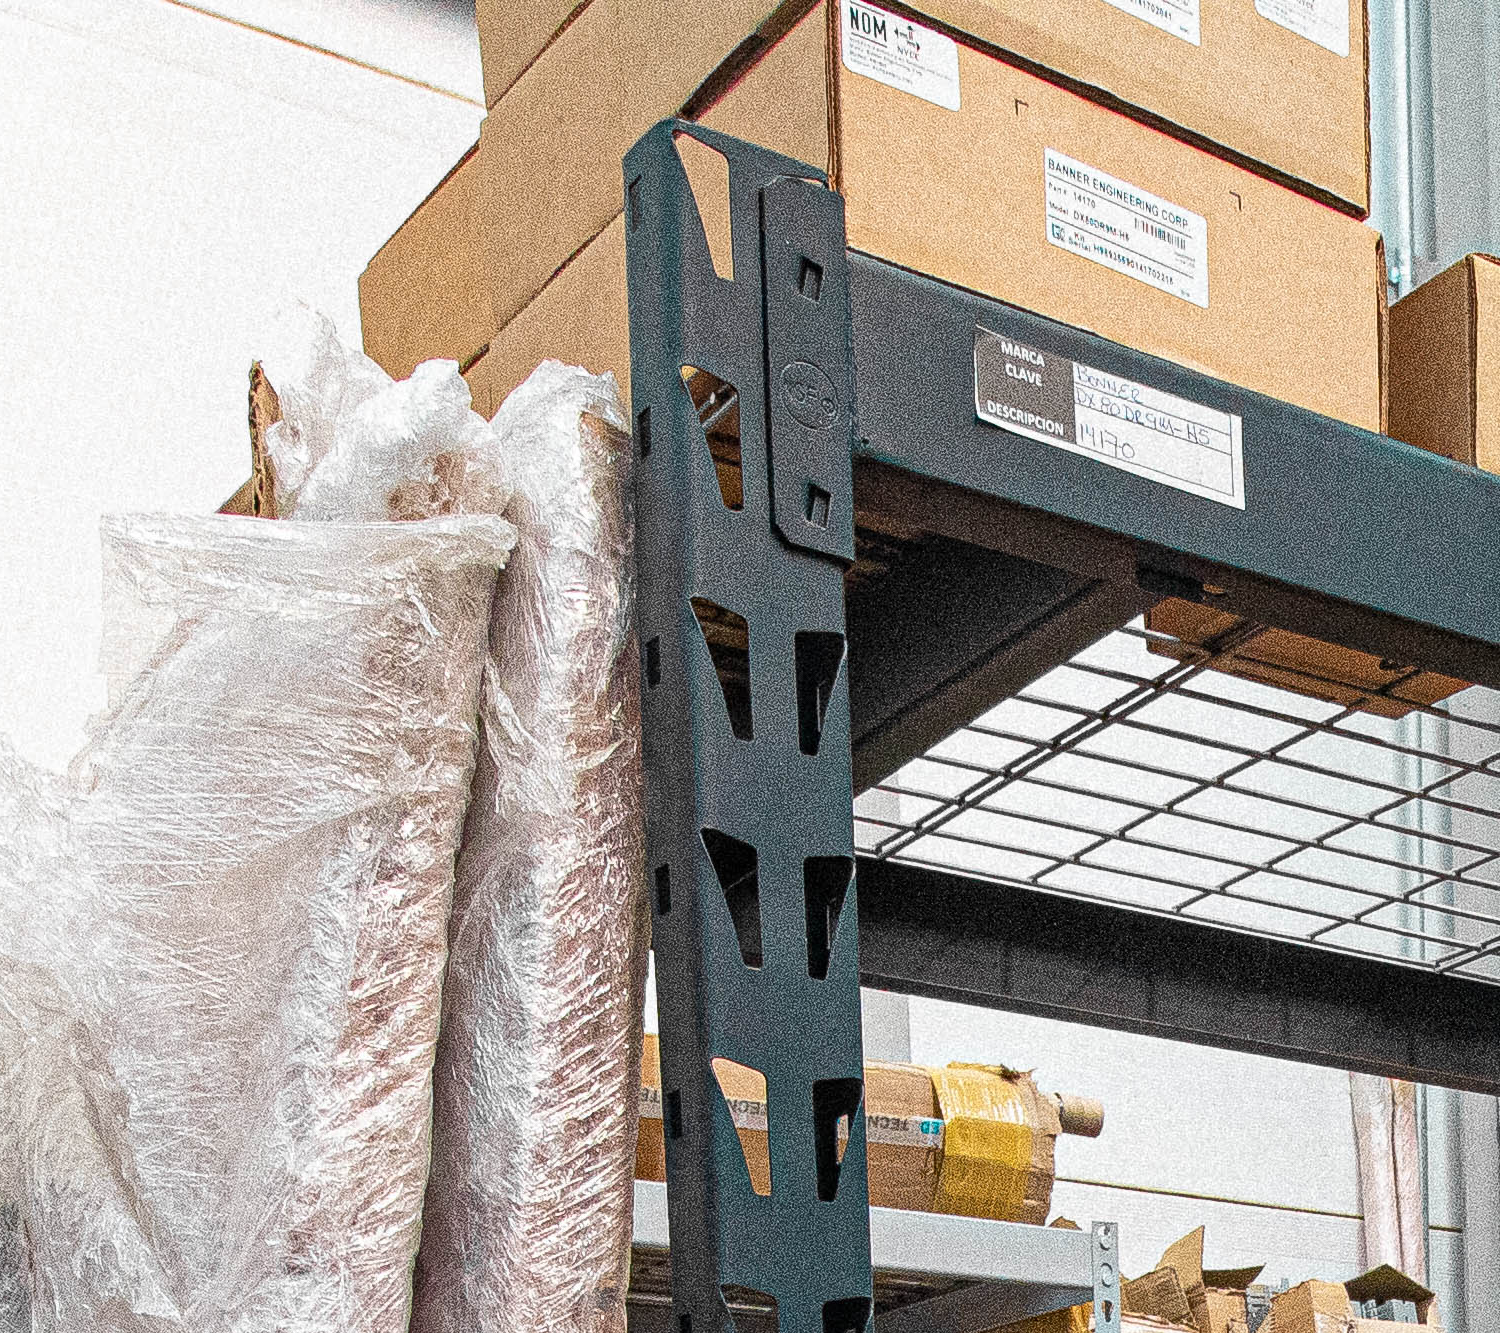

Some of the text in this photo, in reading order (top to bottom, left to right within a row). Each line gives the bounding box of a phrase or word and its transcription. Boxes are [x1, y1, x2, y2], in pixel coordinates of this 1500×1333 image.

[849, 7, 887, 41] NOM
[1048, 159, 1090, 184] BANNER
[1092, 176, 1159, 218] ENGINEERING
[1001, 341, 1045, 367] MARCA
[1005, 362, 1043, 387] CLAVE
[987, 400, 1064, 435] DESCRIPCION
